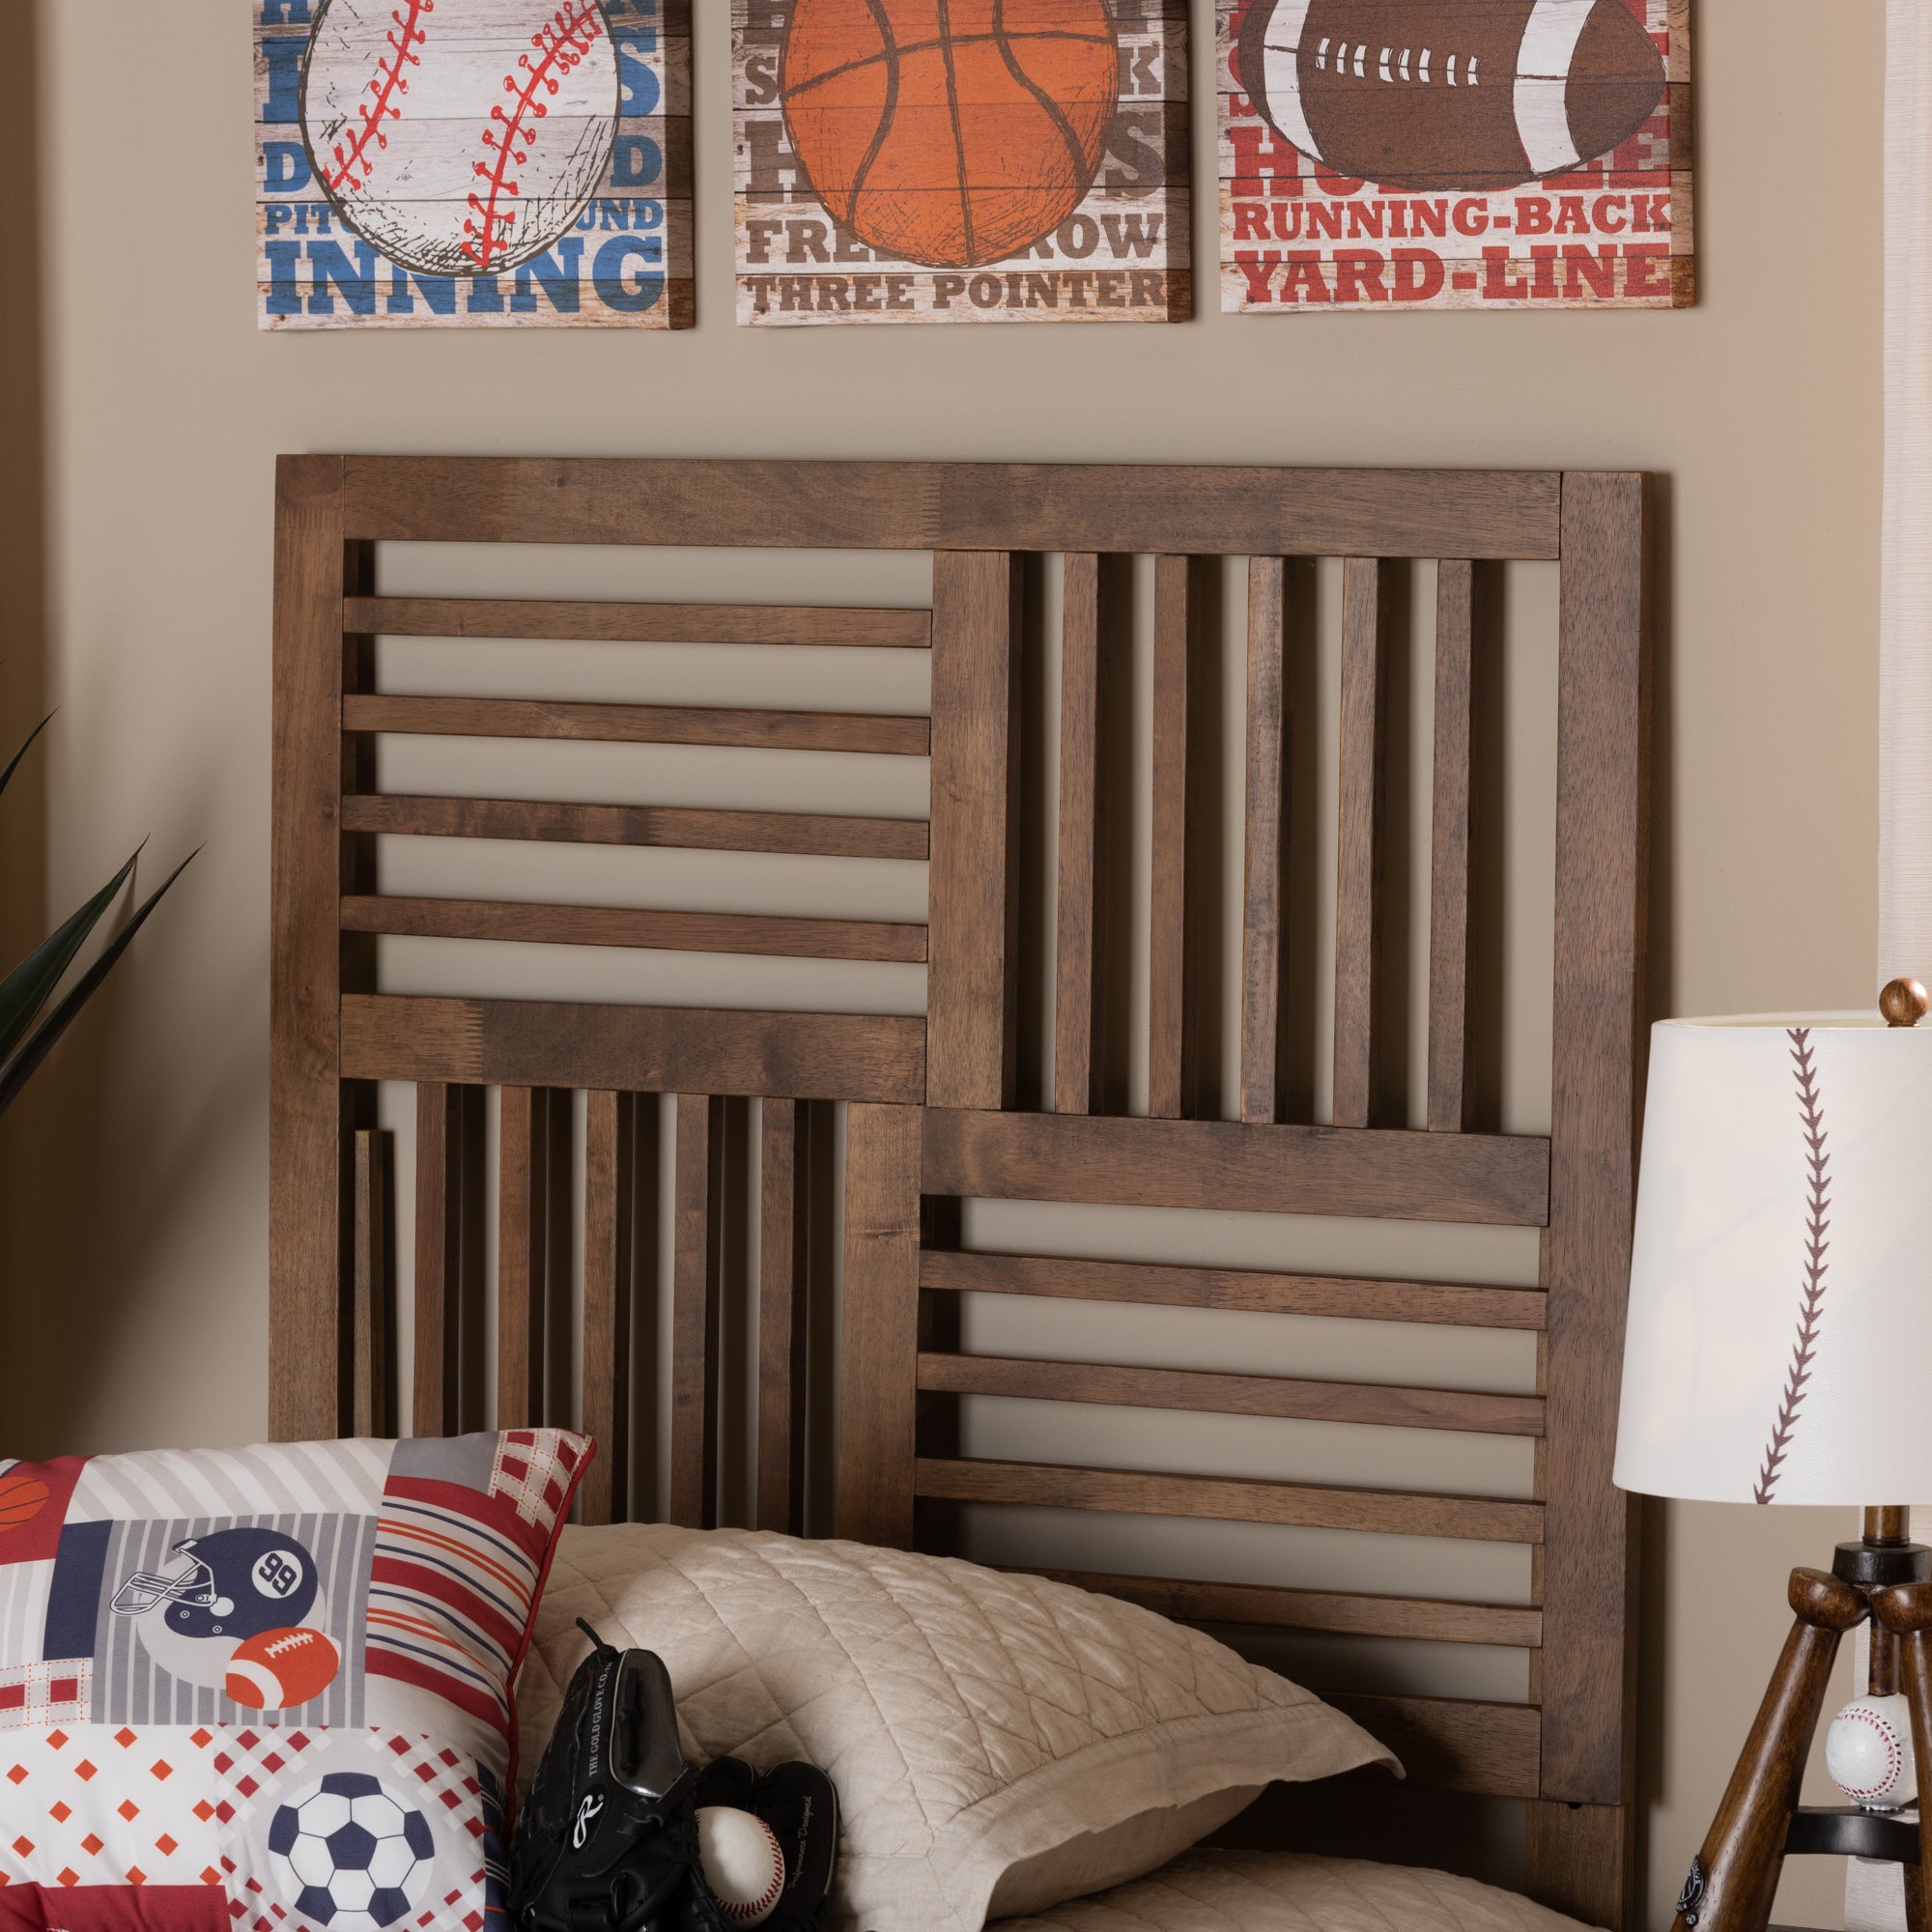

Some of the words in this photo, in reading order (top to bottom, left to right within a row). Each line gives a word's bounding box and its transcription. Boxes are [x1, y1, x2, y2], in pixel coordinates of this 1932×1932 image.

[1233, 193, 1672, 241] RUNNING-BACK
[747, 275, 915, 311] THREE
[932, 271, 1168, 309] POINTER
[1235, 242, 1671, 303] YARD-LINE
[258, 1552, 298, 1596] 99
[592, 1688, 605, 1723] GLOVE
[590, 1724, 600, 1753] GOLD
[589, 1753, 599, 1777] THE
